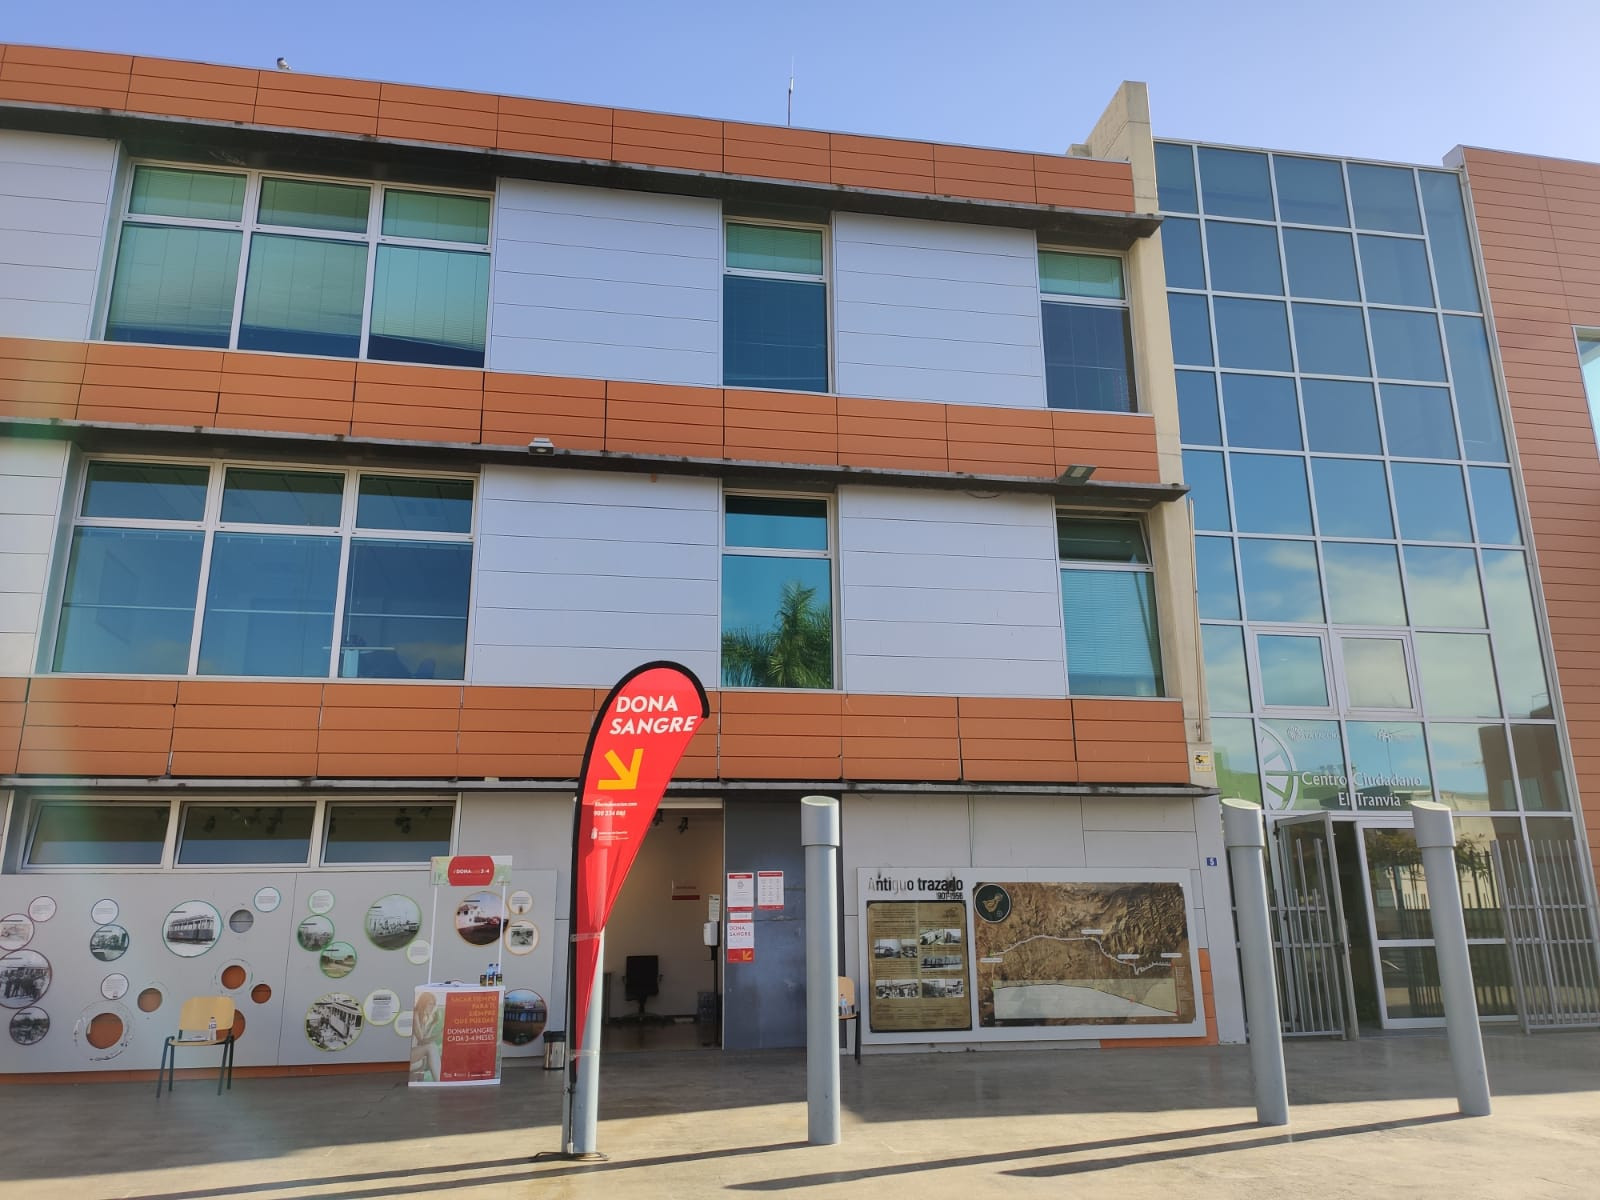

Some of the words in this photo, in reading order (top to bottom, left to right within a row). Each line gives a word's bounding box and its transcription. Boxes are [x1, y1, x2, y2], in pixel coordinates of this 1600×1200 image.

[616, 695, 679, 713] DONA
[609, 715, 698, 735] SANGRE
[1302, 771, 1348, 786] Centro
[1353, 772, 1422, 787] Ciudadano
[1338, 792, 1350, 807] El
[1355, 791, 1401, 807] Tranvía
[868, 877, 914, 895] Antiguo
[918, 876, 963, 891] trazado
